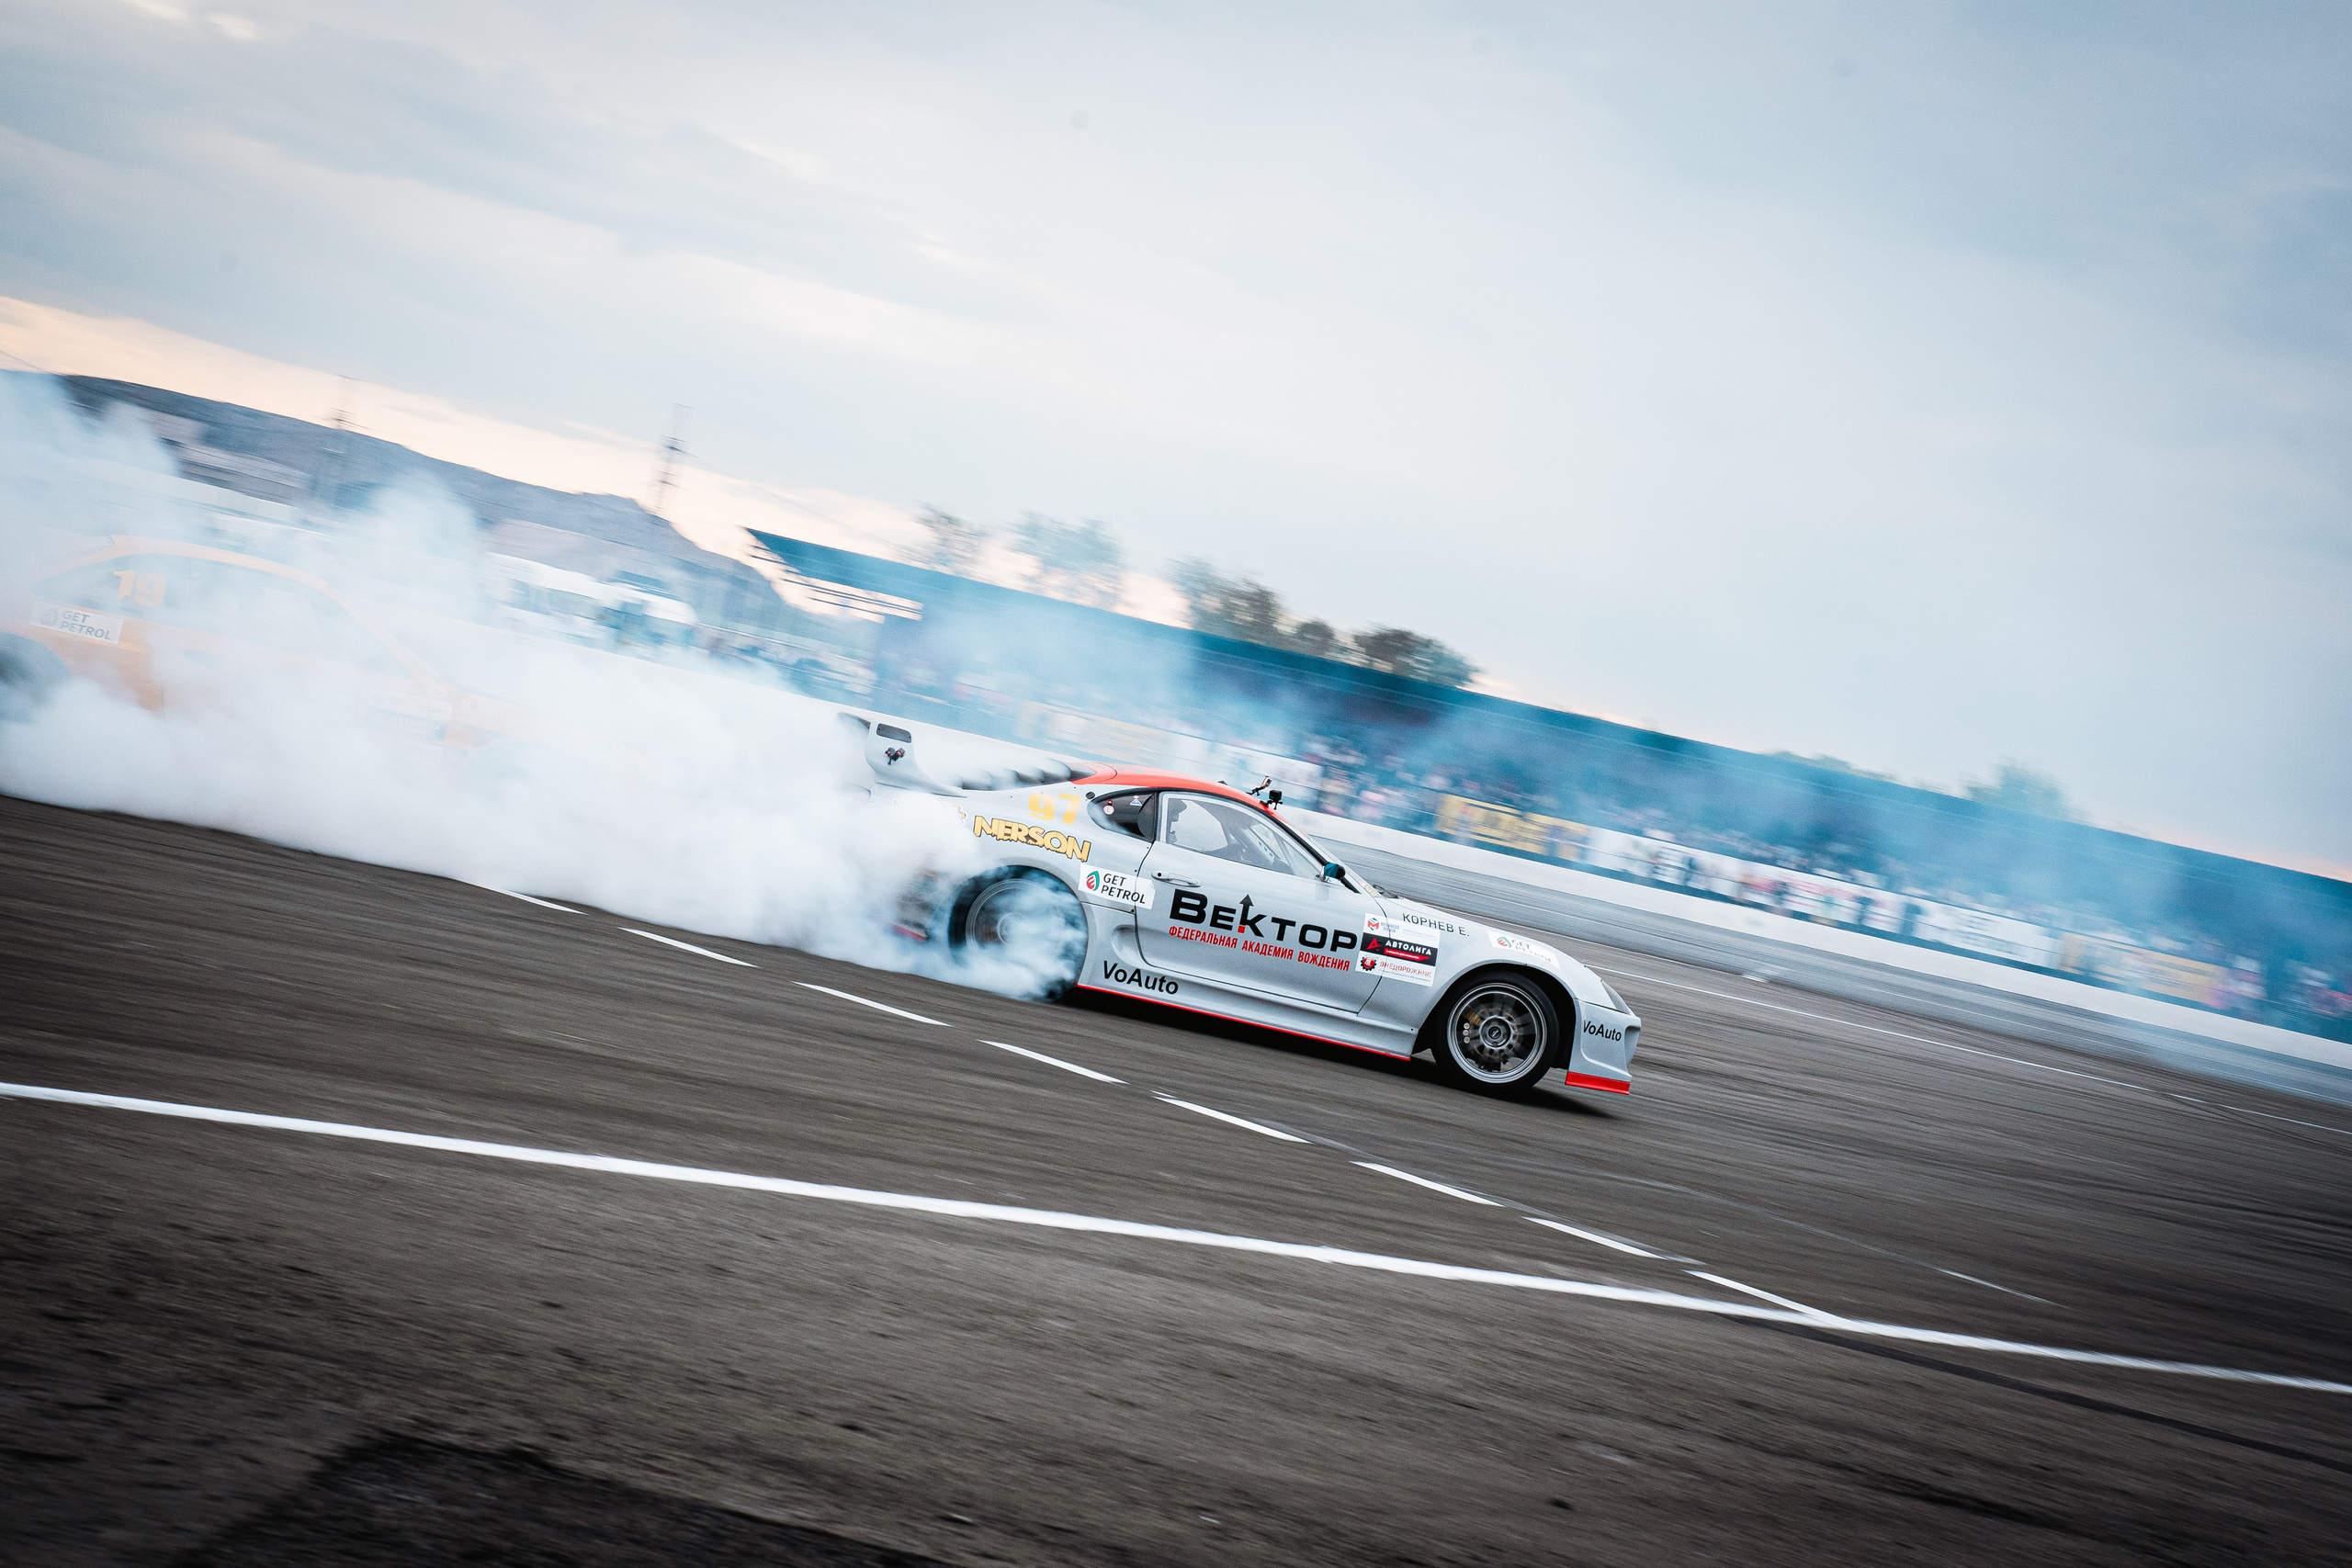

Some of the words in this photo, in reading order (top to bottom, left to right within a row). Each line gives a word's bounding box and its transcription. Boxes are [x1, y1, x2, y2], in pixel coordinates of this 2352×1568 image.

[113, 570, 166, 606] 19
[62, 611, 90, 624] GET
[60, 621, 111, 640] PETROL
[1027, 793, 1082, 825] 97
[973, 816, 1091, 863] NERSON
[1102, 873, 1127, 887] GET
[1101, 885, 1146, 905] PETROL
[1402, 912, 1454, 933] КОРНЕВ
[1458, 926, 1470, 937] Е.
[1169, 925, 1238, 949] ФЕДЕРАЛЬНАЯ
[1241, 940, 1294, 960] АКАДЕМИЯ
[1297, 951, 1351, 972] ВОЖДЕНИЯ
[1385, 940, 1431, 955] АВТОЛИГА
[1103, 960, 1179, 995] VoAuto
[1379, 961, 1431, 977] ВНЕДОРОЖНИК
[1583, 1020, 1622, 1042] VoAuto
